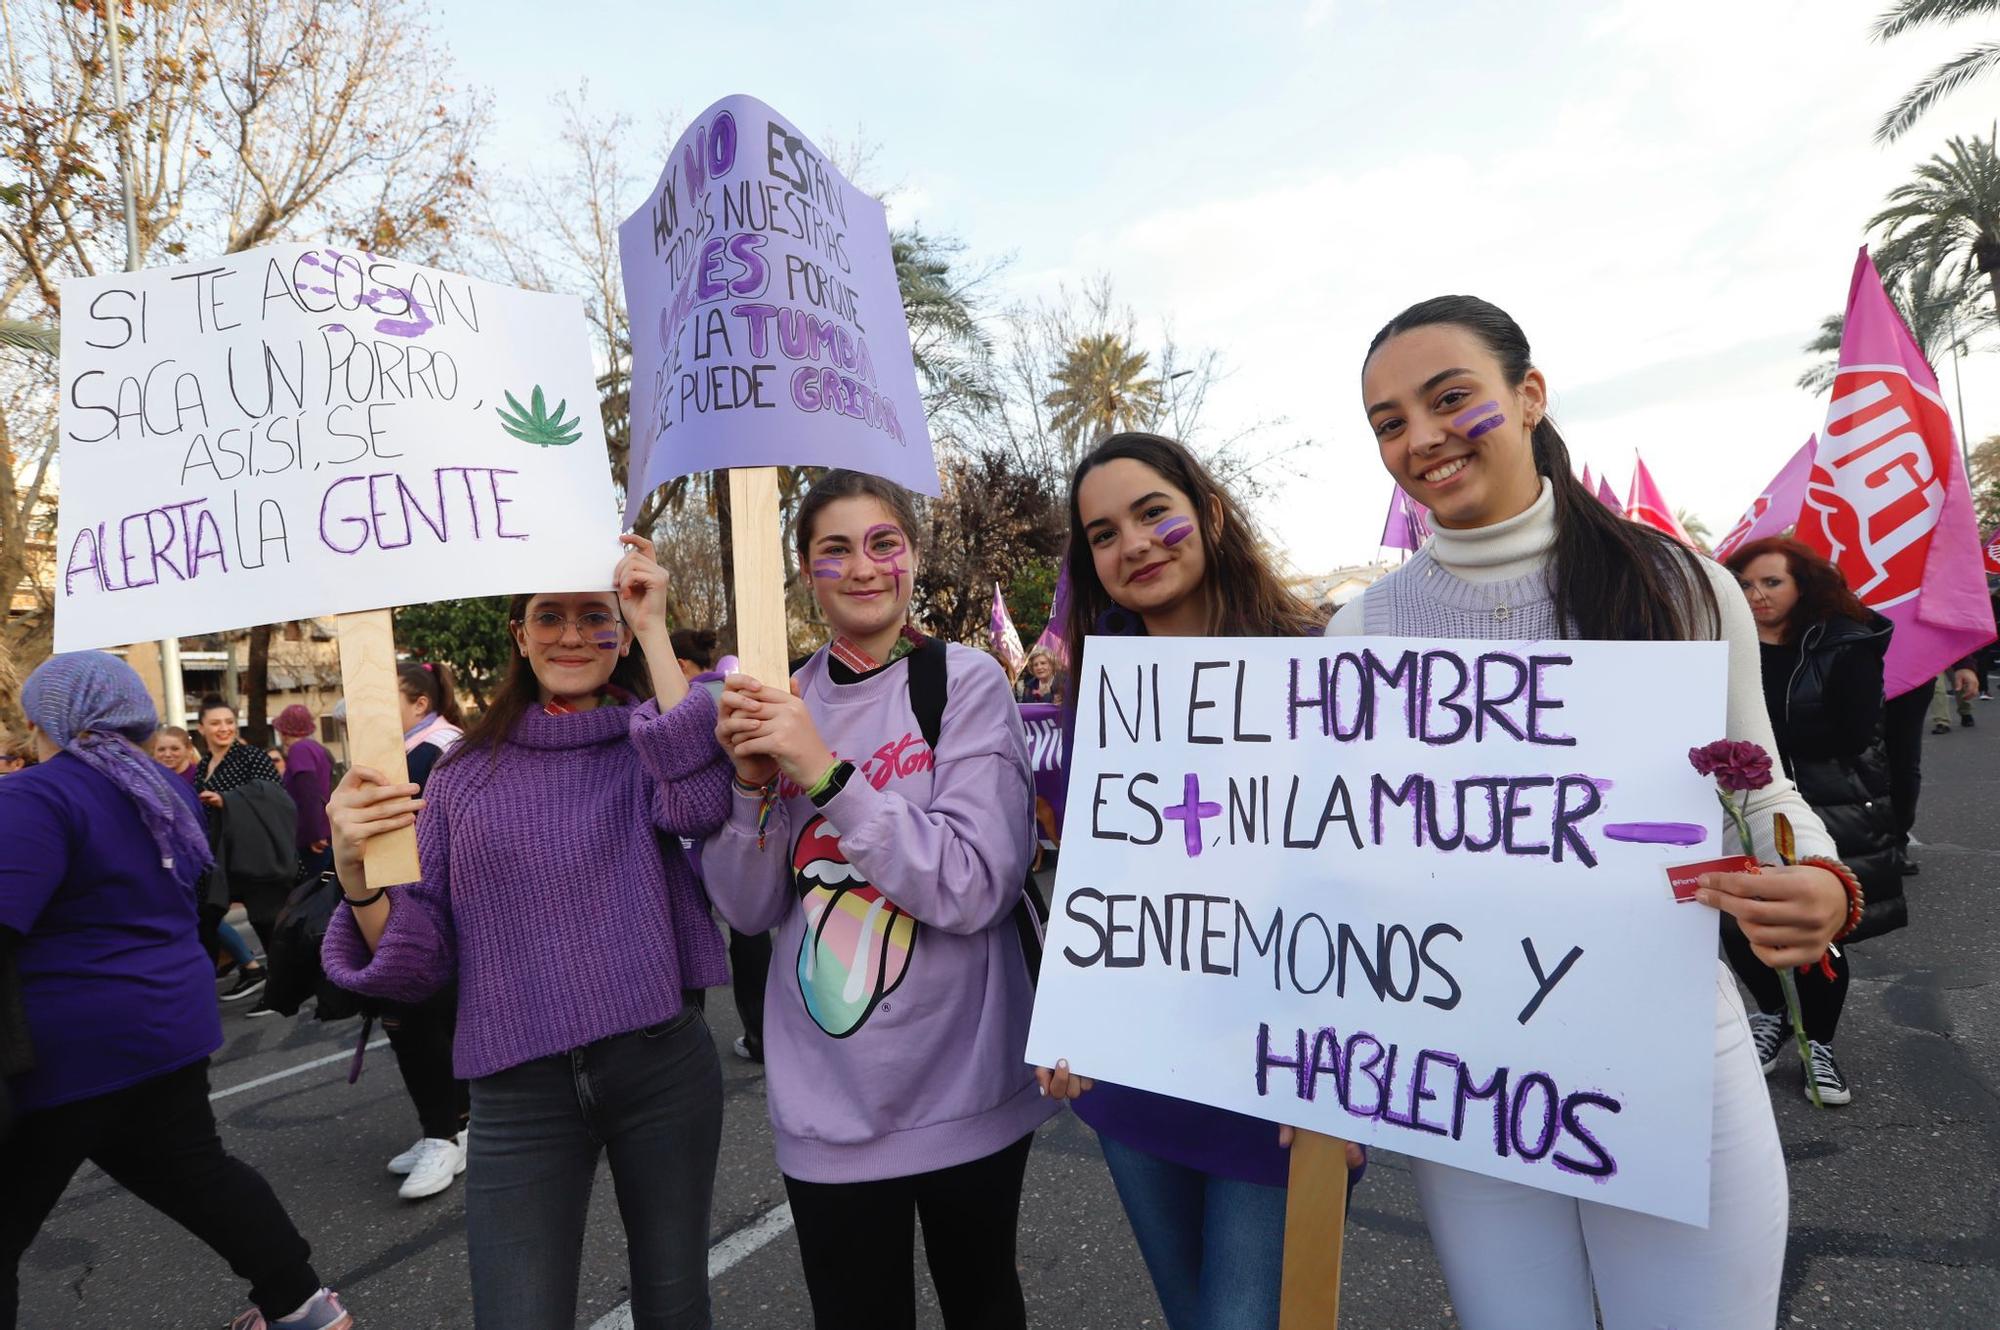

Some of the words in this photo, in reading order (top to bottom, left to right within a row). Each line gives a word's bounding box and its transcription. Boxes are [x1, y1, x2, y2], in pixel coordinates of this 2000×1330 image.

[653, 164, 679, 256] HOY
[683, 109, 738, 208] NO
[767, 121, 847, 229] ESTÁN
[665, 191, 715, 291] TODAS
[723, 180, 851, 274] NUESTRAS
[85, 289, 147, 349] SI
[171, 267, 242, 334] TE
[261, 254, 481, 333] ACOSAN
[786, 254, 865, 334] PORQUE
[68, 360, 208, 443] SACA
[228, 340, 303, 422] UN
[694, 308, 733, 361] LA
[731, 304, 878, 389] TUMBA
[656, 385, 674, 442] SE
[681, 365, 777, 423] PUEDE
[789, 366, 907, 447] GRITAR
[64, 497, 229, 597] ALERTA
[233, 489, 290, 569] LA
[319, 466, 530, 555] GENTE
[1098, 662, 1161, 748] NI
[1187, 660, 1272, 745] EL
[1287, 647, 1577, 748] HOMBRE
[871, 732, 934, 791] Ston
[1092, 771, 1163, 846] ES
[1228, 775, 1269, 846] NI
[1283, 774, 1364, 850] LA
[1369, 771, 1603, 869] MUJER
[1062, 886, 1463, 1011] SENTEMONOS
[1516, 936, 1585, 1025] Y
[1255, 1022, 1622, 1183] HABLEMOS
